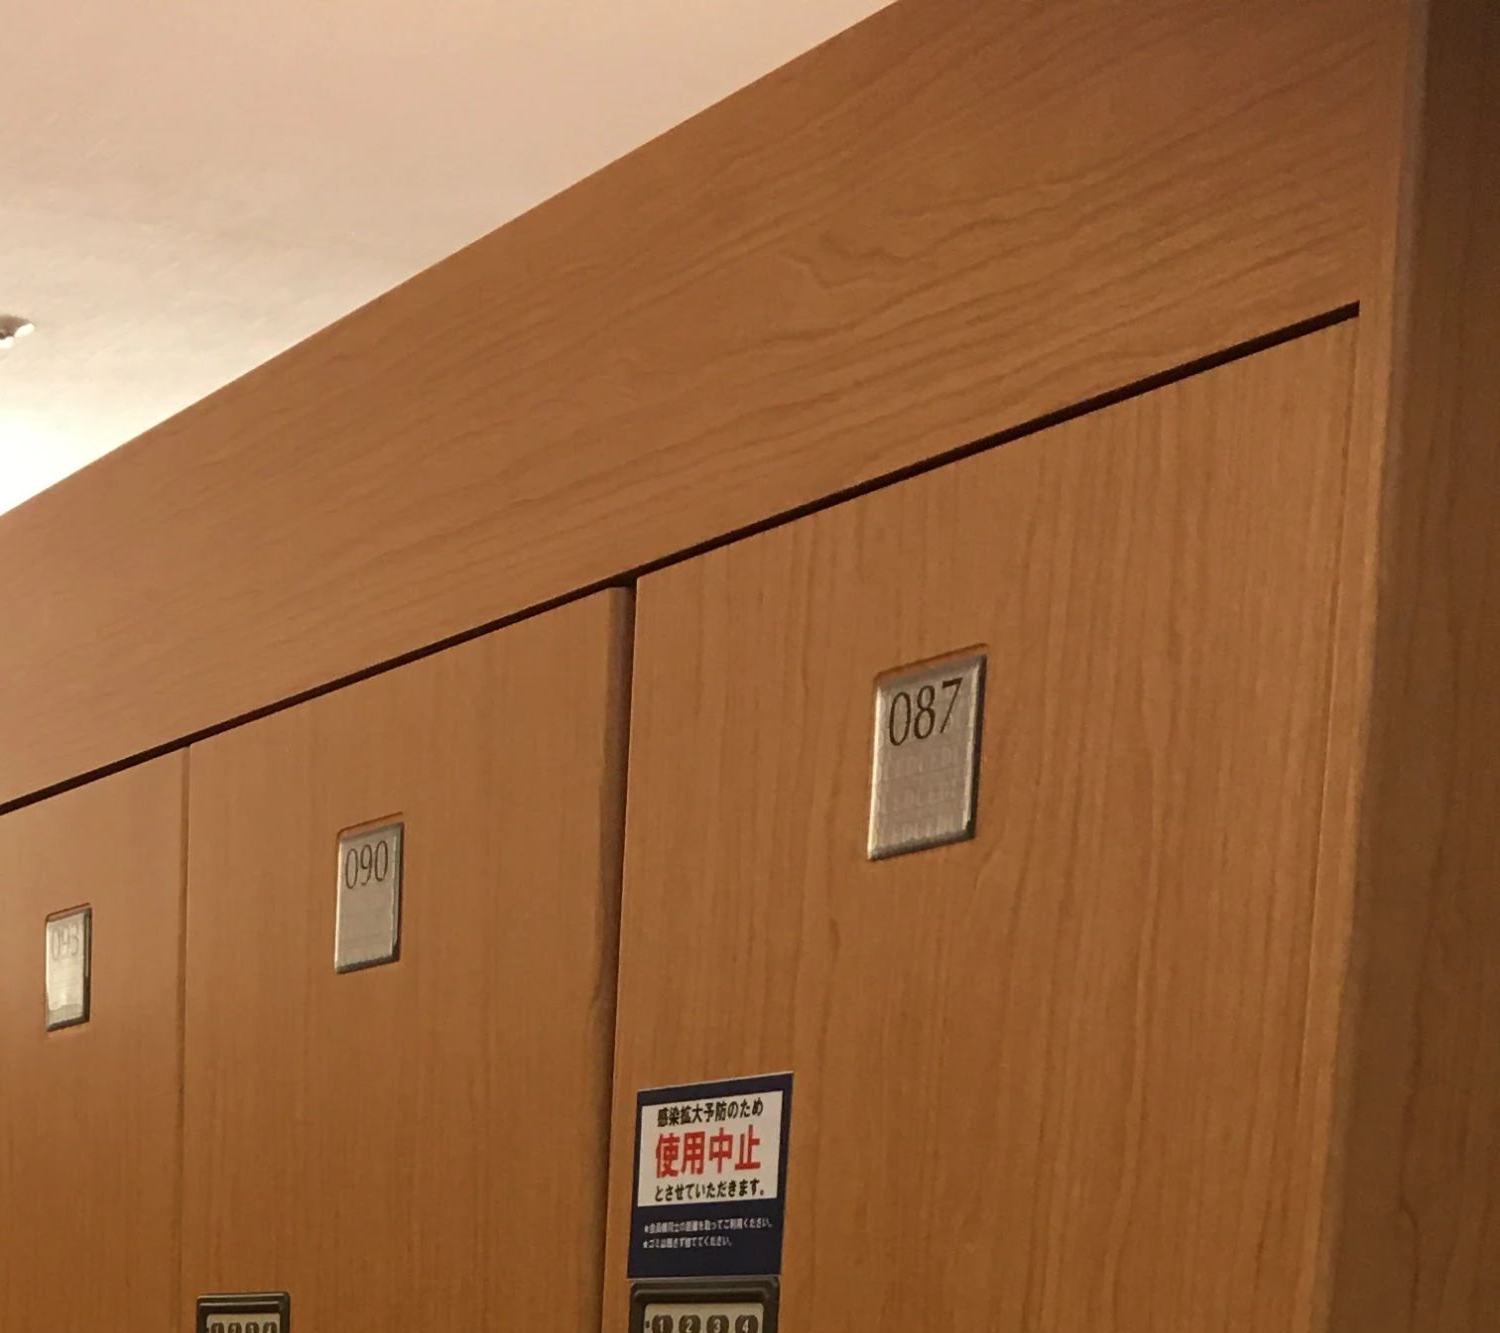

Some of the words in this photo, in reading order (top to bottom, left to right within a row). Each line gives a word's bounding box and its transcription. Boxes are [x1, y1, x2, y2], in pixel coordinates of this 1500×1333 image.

[889, 677, 963, 746] 087
[345, 840, 388, 889] 090
[657, 1097, 764, 1127] 感染拡大予防のため
[655, 1124, 762, 1179] 使用中止
[654, 1178, 765, 1202] とさせていただきます。
